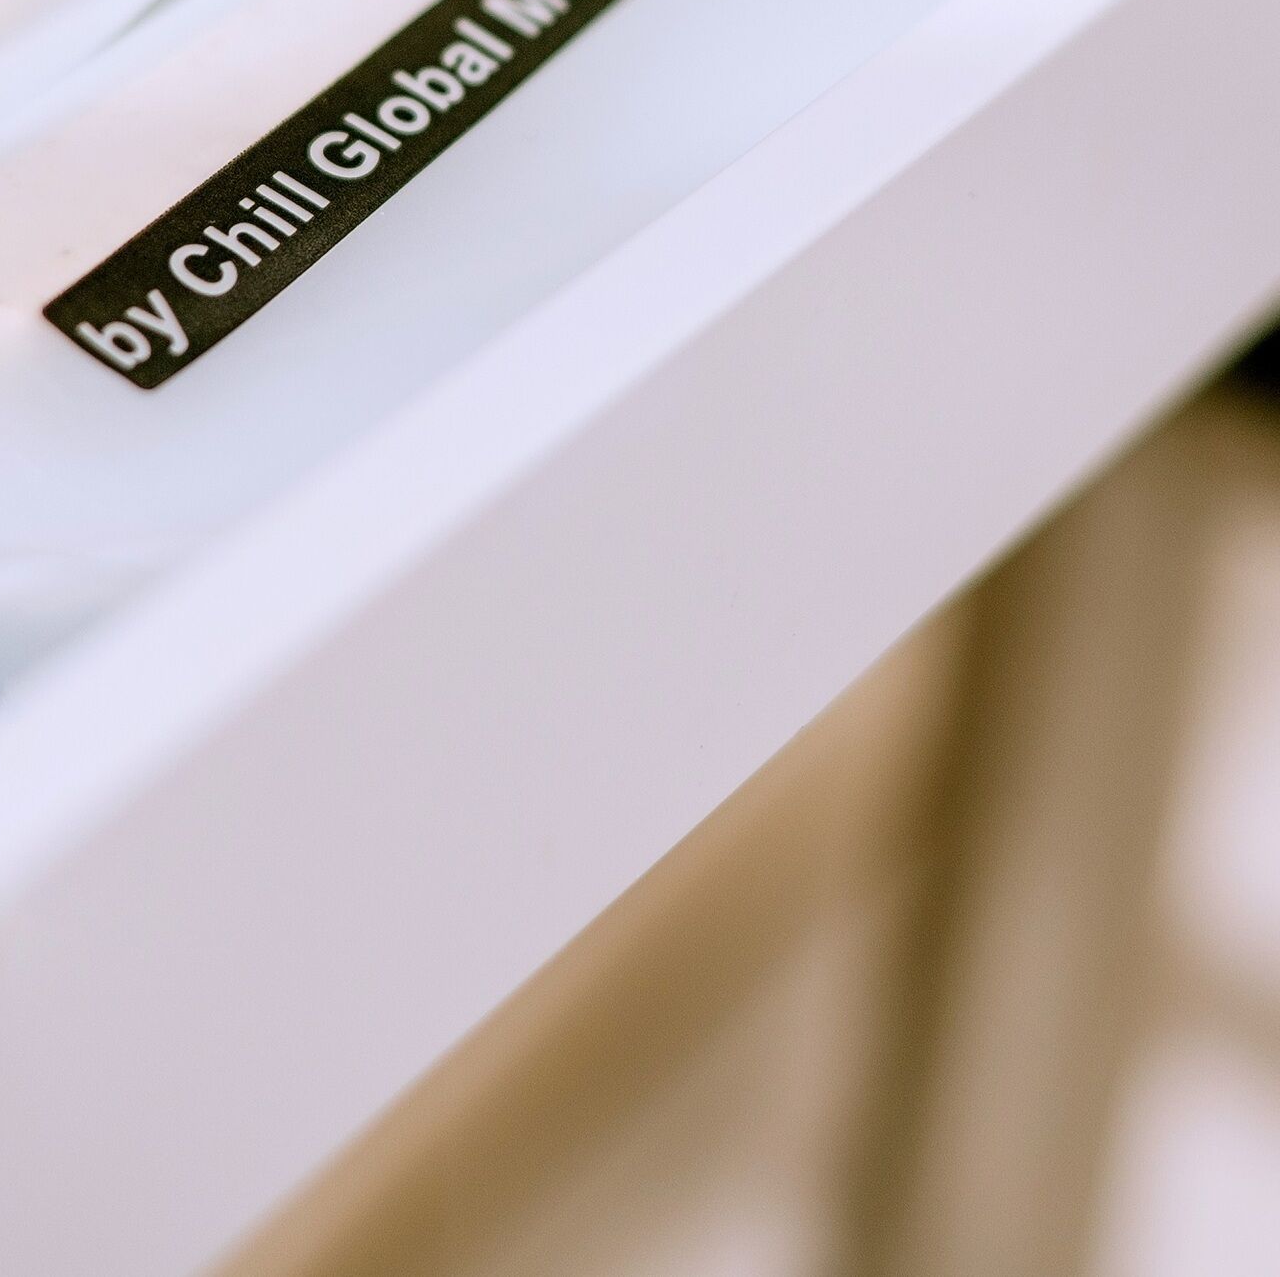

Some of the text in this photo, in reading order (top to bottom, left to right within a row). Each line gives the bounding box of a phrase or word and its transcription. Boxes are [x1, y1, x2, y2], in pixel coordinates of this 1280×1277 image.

[75, 287, 190, 372] by
[168, 170, 331, 298] Chill
[308, 20, 515, 182] Global
